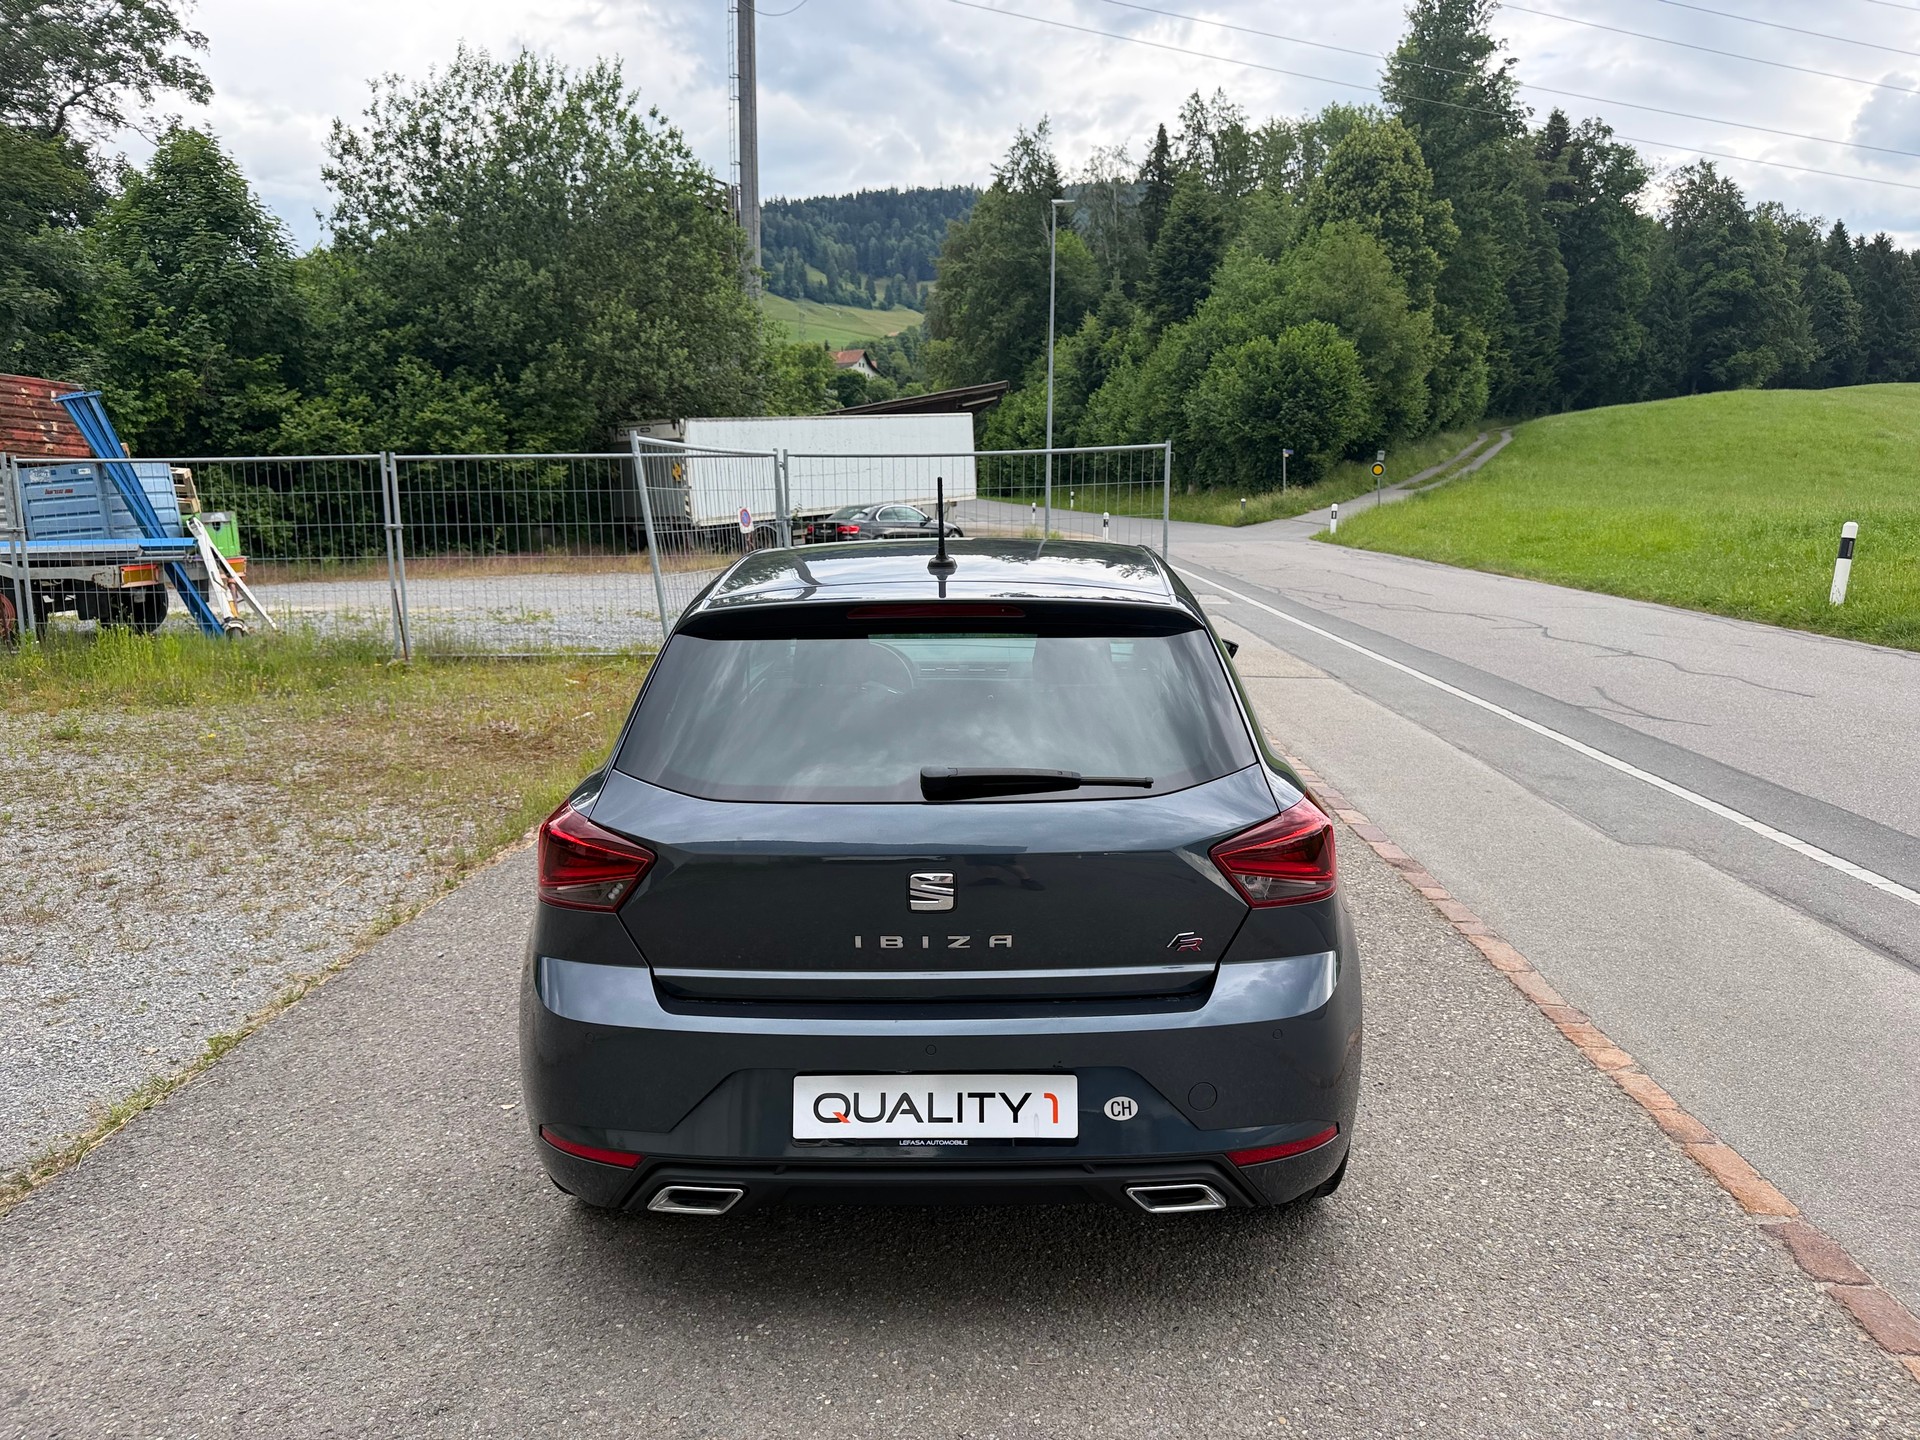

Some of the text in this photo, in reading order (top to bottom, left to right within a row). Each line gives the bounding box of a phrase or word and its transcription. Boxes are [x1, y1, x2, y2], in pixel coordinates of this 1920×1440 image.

[854, 935, 1013, 949] IBIZA
[1166, 931, 1203, 952] FR
[813, 1092, 1059, 1124] QUALITY 1
[1110, 1100, 1132, 1117] CH
